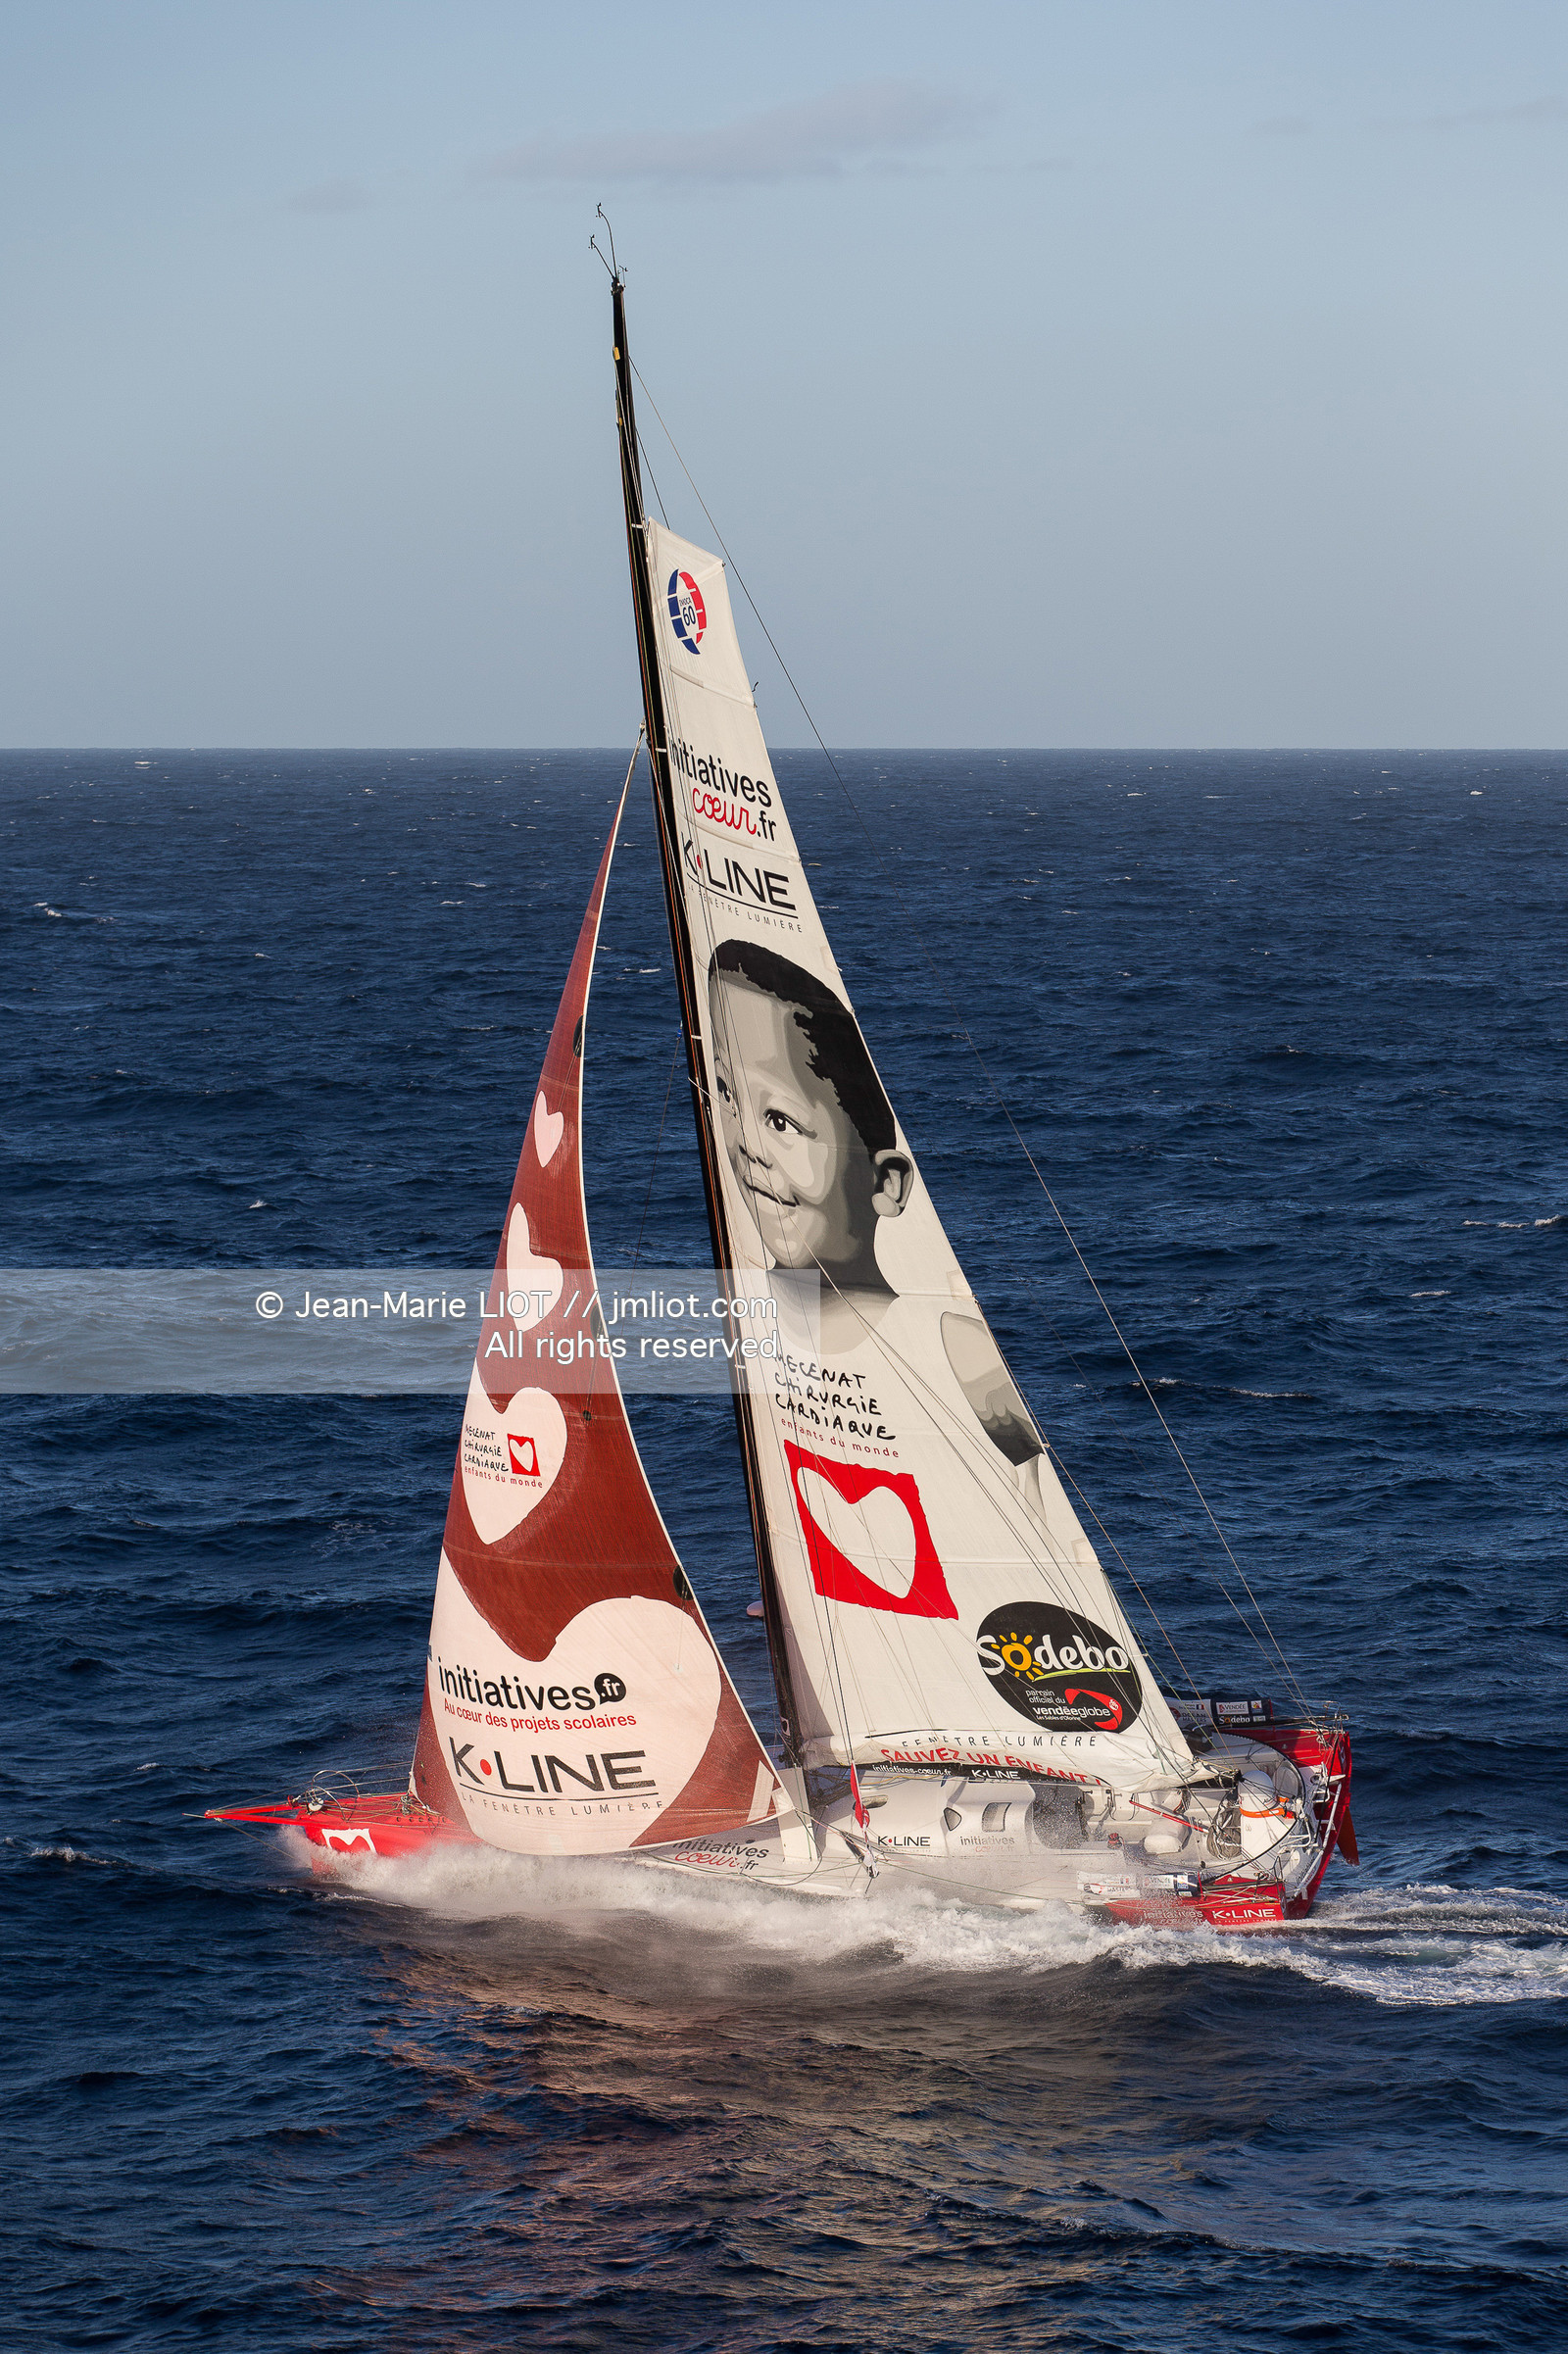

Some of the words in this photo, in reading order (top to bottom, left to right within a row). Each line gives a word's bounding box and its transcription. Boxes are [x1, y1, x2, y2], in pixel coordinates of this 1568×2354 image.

[682, 605, 697, 627] 60
[781, 1418, 824, 1442] enfants
[830, 1436, 845, 1448] du
[852, 1443, 900, 1458] monde
[495, 1474, 506, 1483] du
[510, 1478, 543, 1489] monde
[976, 1633, 1129, 1676] Sodebo
[438, 1655, 596, 1711] initiatives
[1025, 1689, 1055, 1697] parrain
[444, 1697, 456, 1714] Au
[485, 1711, 508, 1728] des
[510, 1716, 560, 1734] projets
[564, 1713, 637, 1731] scolaires
[1219, 1715, 1250, 1725] Sodebo
[880, 1747, 965, 1762] SAUVEZ
[966, 1751, 1002, 1766] UN
[1004, 1755, 1088, 1783] ENFANT
